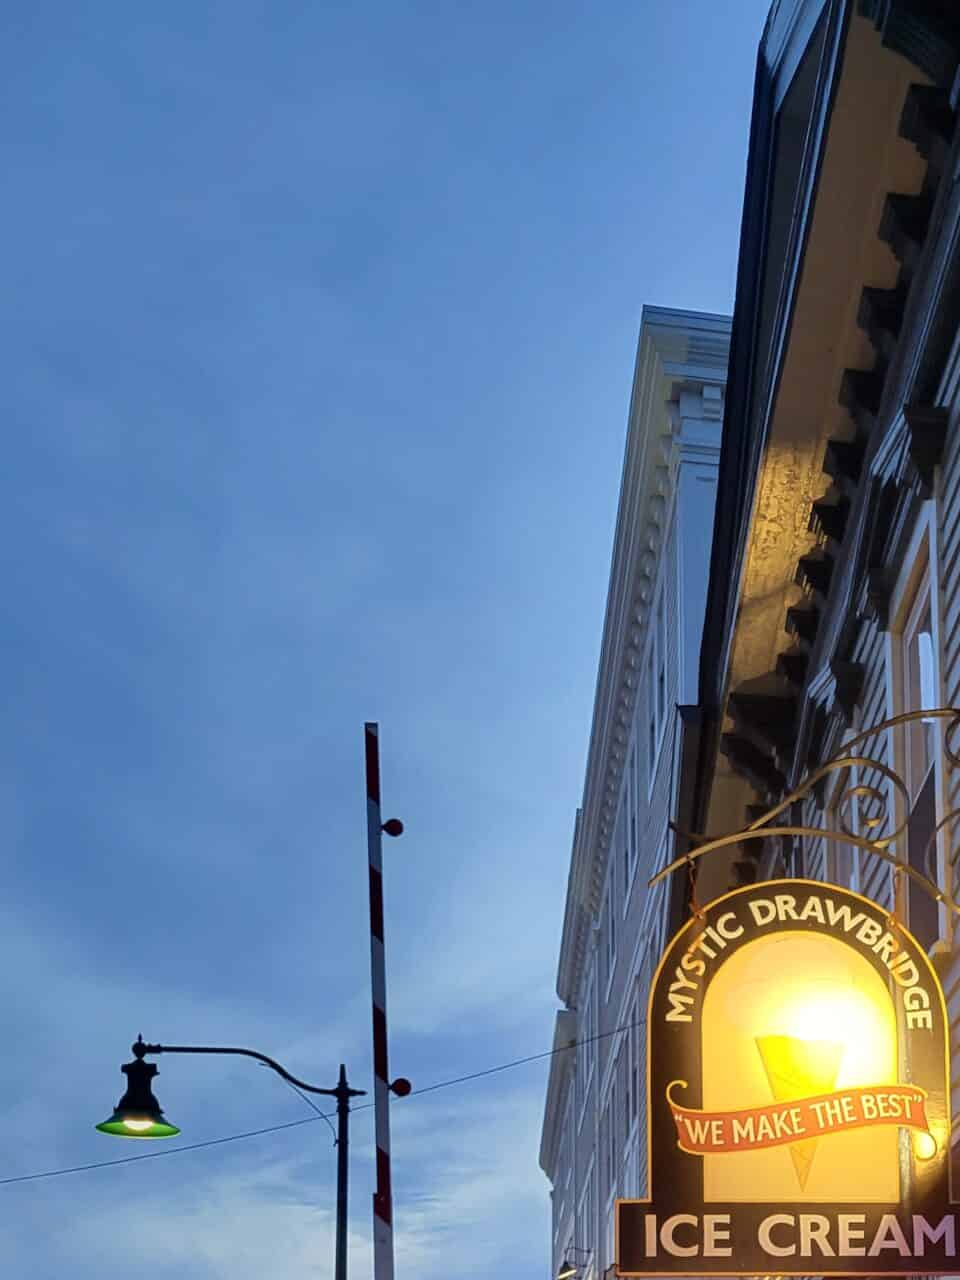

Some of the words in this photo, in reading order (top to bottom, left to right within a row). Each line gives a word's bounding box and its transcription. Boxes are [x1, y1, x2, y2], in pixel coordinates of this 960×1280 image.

[665, 911, 744, 1022] MYSTIC
[749, 894, 933, 1031] DRAWBRIDGE
[732, 1109, 806, 1144] MAKE
[810, 1096, 857, 1128] THE
[644, 1214, 732, 1257] ICE
[758, 1213, 956, 1257] CREAM
